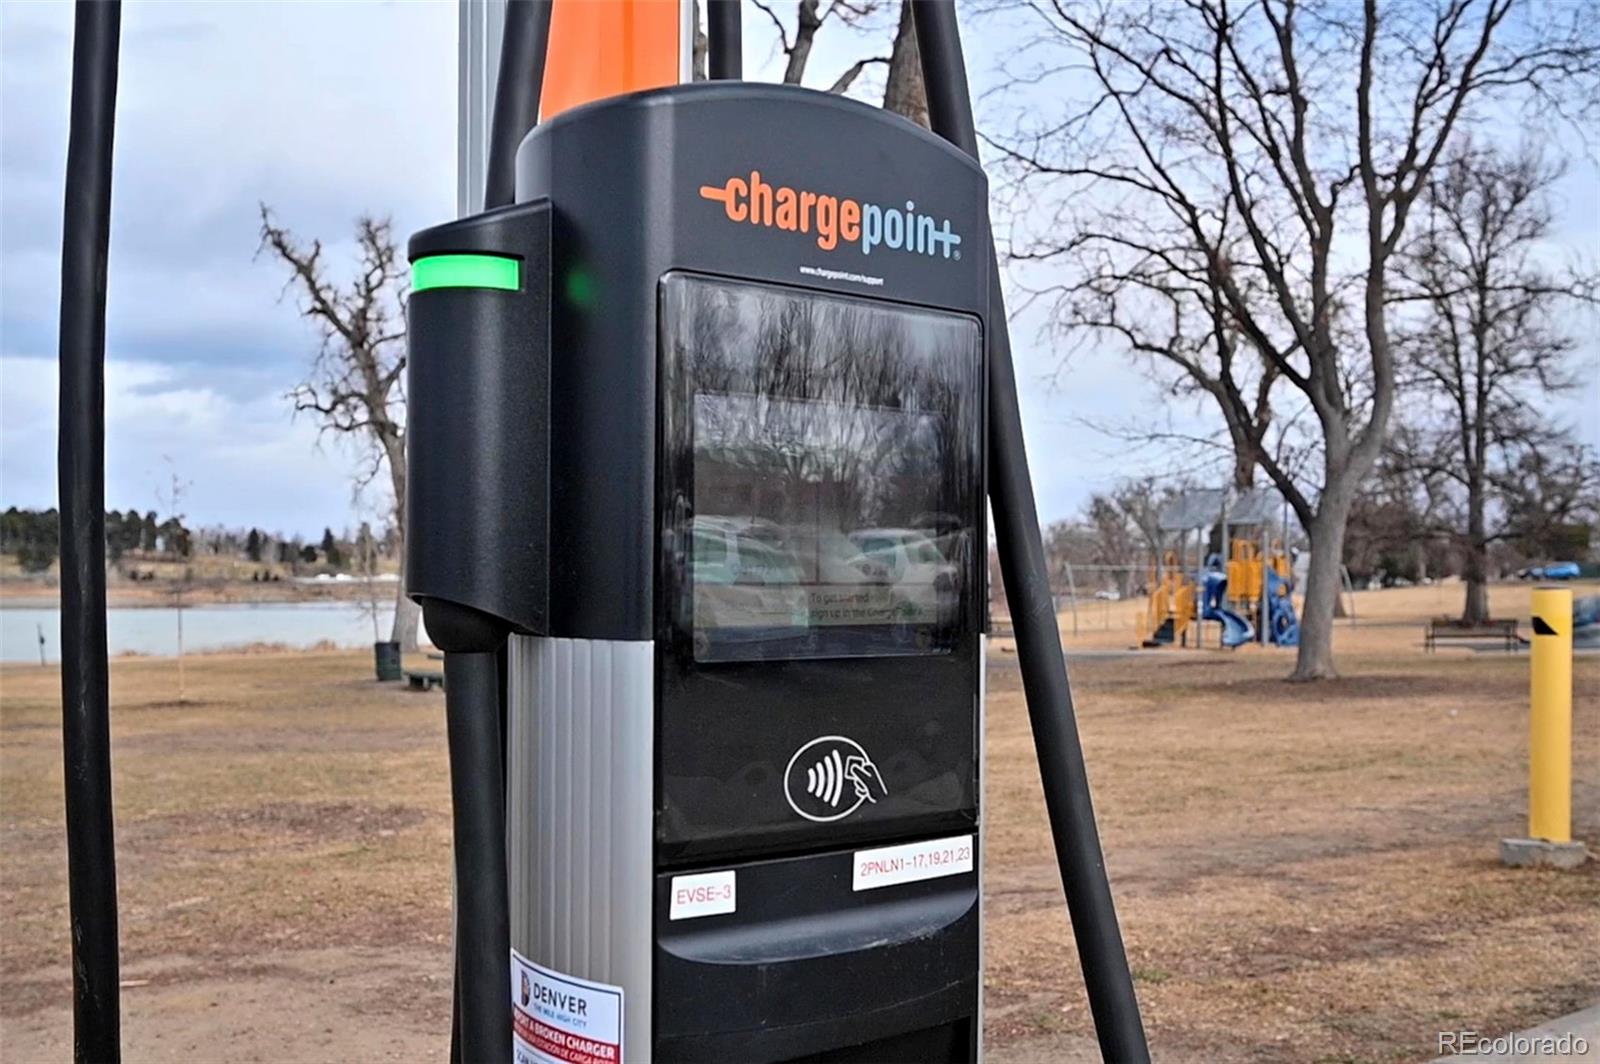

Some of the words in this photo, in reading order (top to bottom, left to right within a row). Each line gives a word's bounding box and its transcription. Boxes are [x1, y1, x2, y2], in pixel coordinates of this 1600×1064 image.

[699, 170, 961, 259] chargepoint
[676, 883, 732, 905] EVSE-3
[533, 982, 588, 1017] DENVER
[566, 1036, 615, 1061] CHARGER
